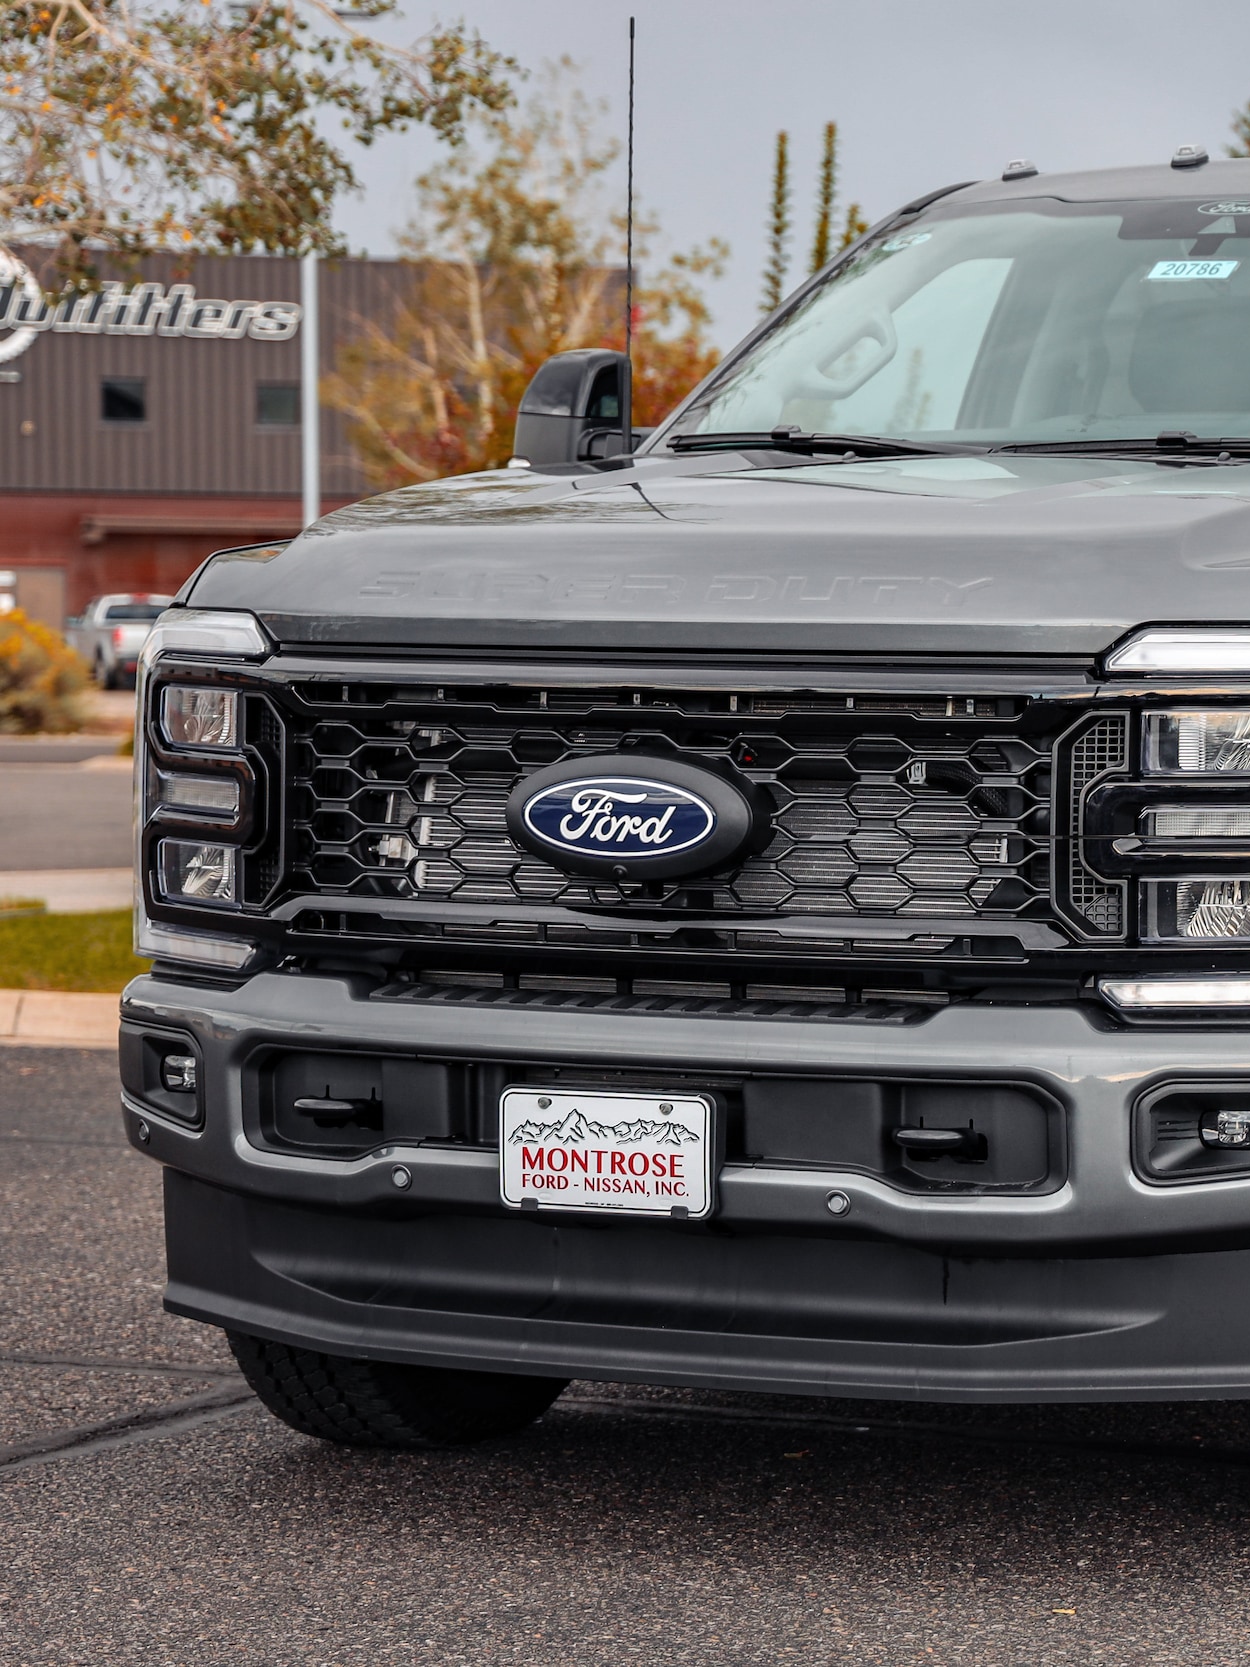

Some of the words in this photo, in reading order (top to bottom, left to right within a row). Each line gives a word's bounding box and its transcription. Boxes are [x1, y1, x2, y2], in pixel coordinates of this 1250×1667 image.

[1160, 263, 1223, 275] 20786
[358, 570, 687, 602] SUPER
[704, 575, 994, 606] DUTY
[559, 788, 677, 844] Ford
[521, 1146, 685, 1178] MONTROSE
[521, 1173, 569, 1190] FORD
[584, 1177, 651, 1197] NISSAN,
[655, 1181, 689, 1197] INC.
